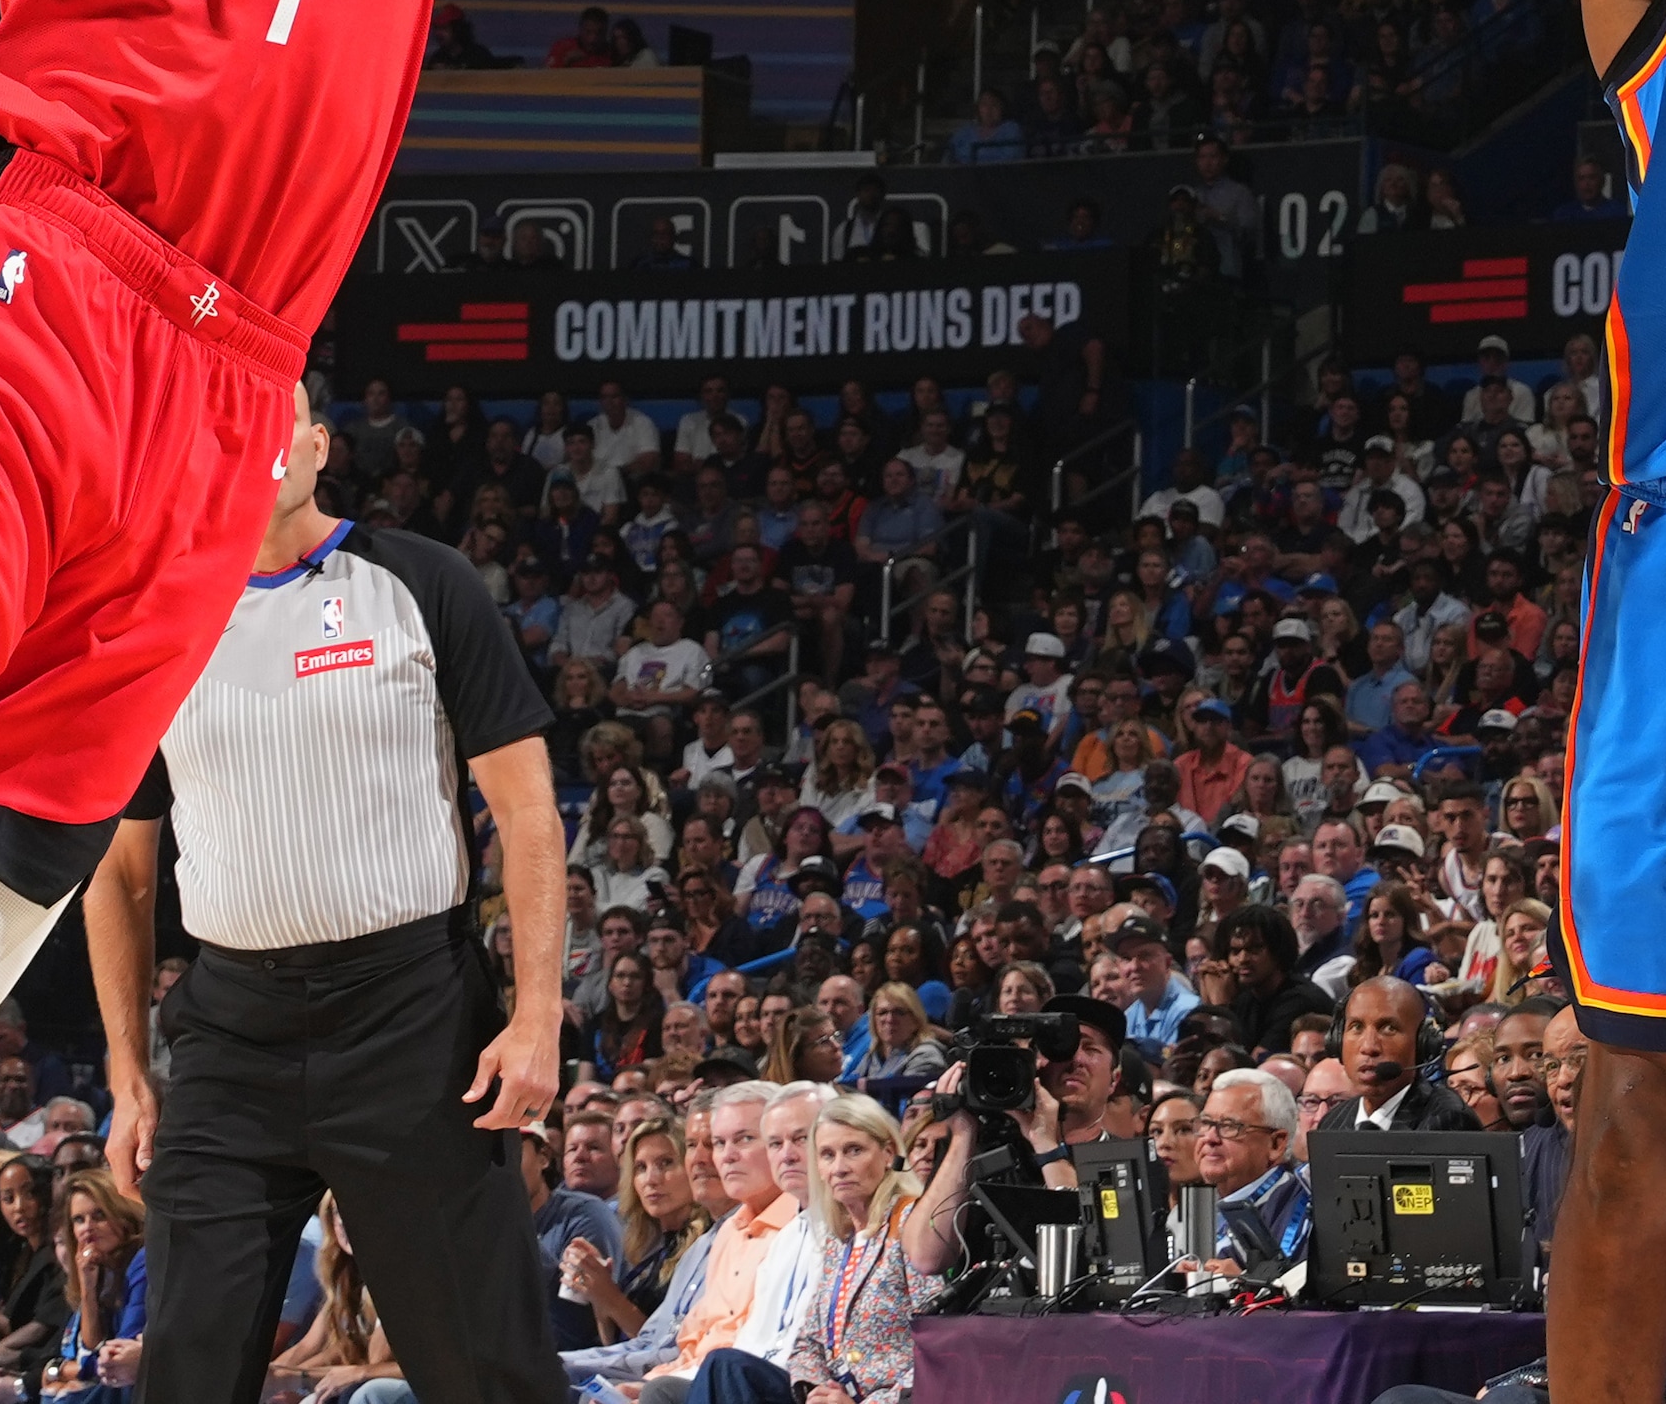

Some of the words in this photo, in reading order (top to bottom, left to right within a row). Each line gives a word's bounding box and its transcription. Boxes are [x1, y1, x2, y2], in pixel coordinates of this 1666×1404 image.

[554, 293, 855, 364] COMMITMENT
[864, 287, 973, 355] RUNS
[980, 281, 1082, 347] DEEP
[296, 647, 373, 673] Emirates
